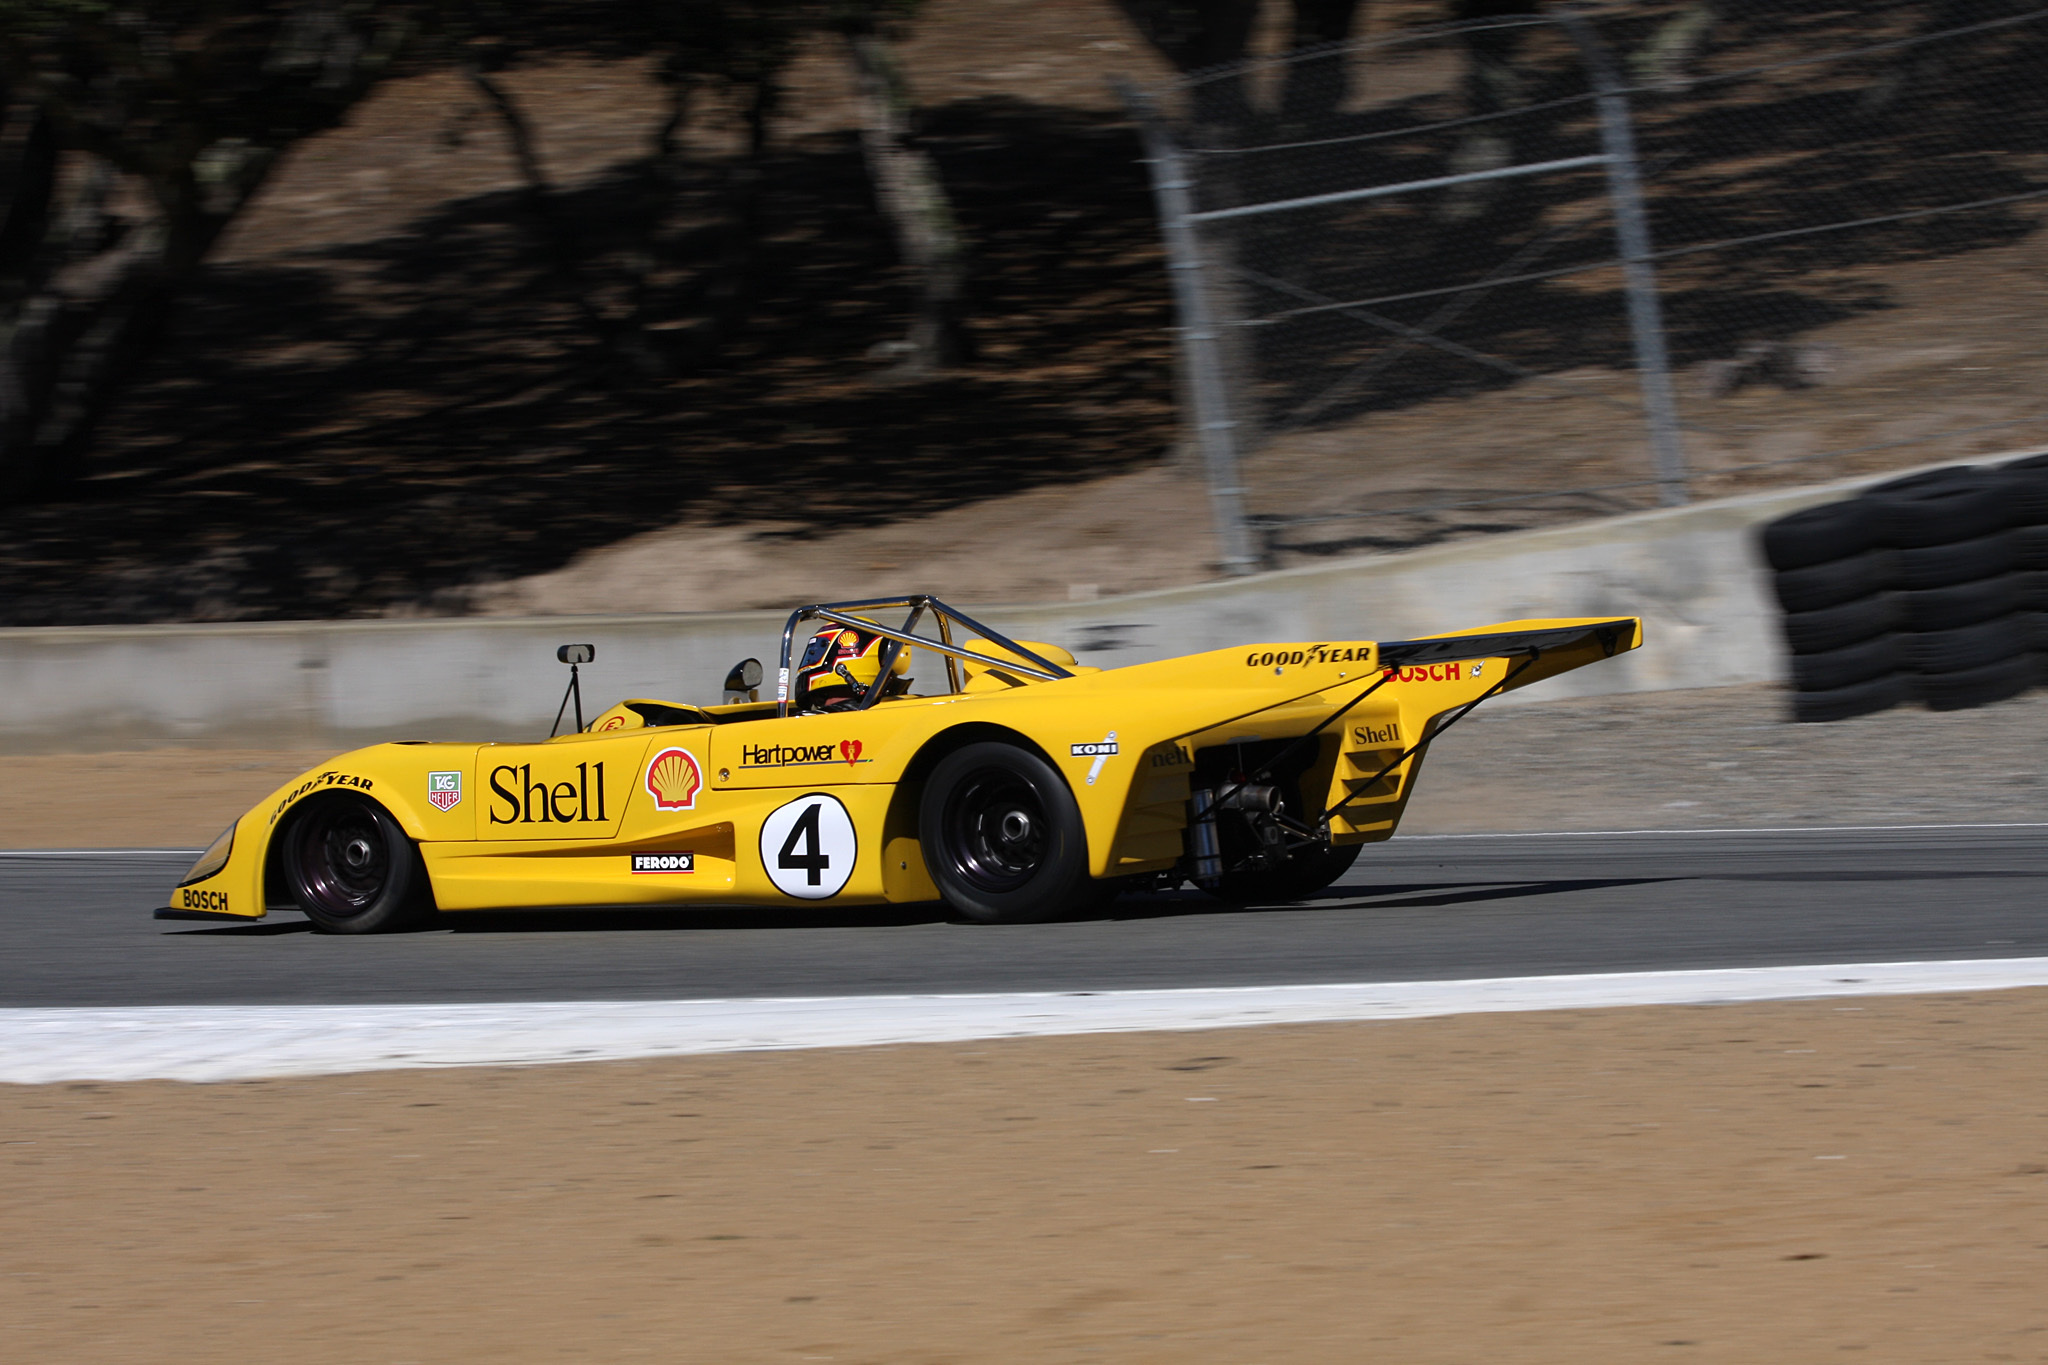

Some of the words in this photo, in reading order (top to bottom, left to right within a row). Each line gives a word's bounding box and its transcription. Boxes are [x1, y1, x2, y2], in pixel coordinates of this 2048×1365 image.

[1354, 723, 1400, 745] Shell
[743, 744, 836, 767] Hartpower
[1072, 744, 1117, 755] KONI
[434, 775, 456, 790] TAG
[489, 761, 610, 825] Shell
[431, 792, 458, 808] HEUER
[777, 803, 830, 886] 4
[635, 856, 690, 869] FERODO
[183, 889, 229, 911] BOSCH
